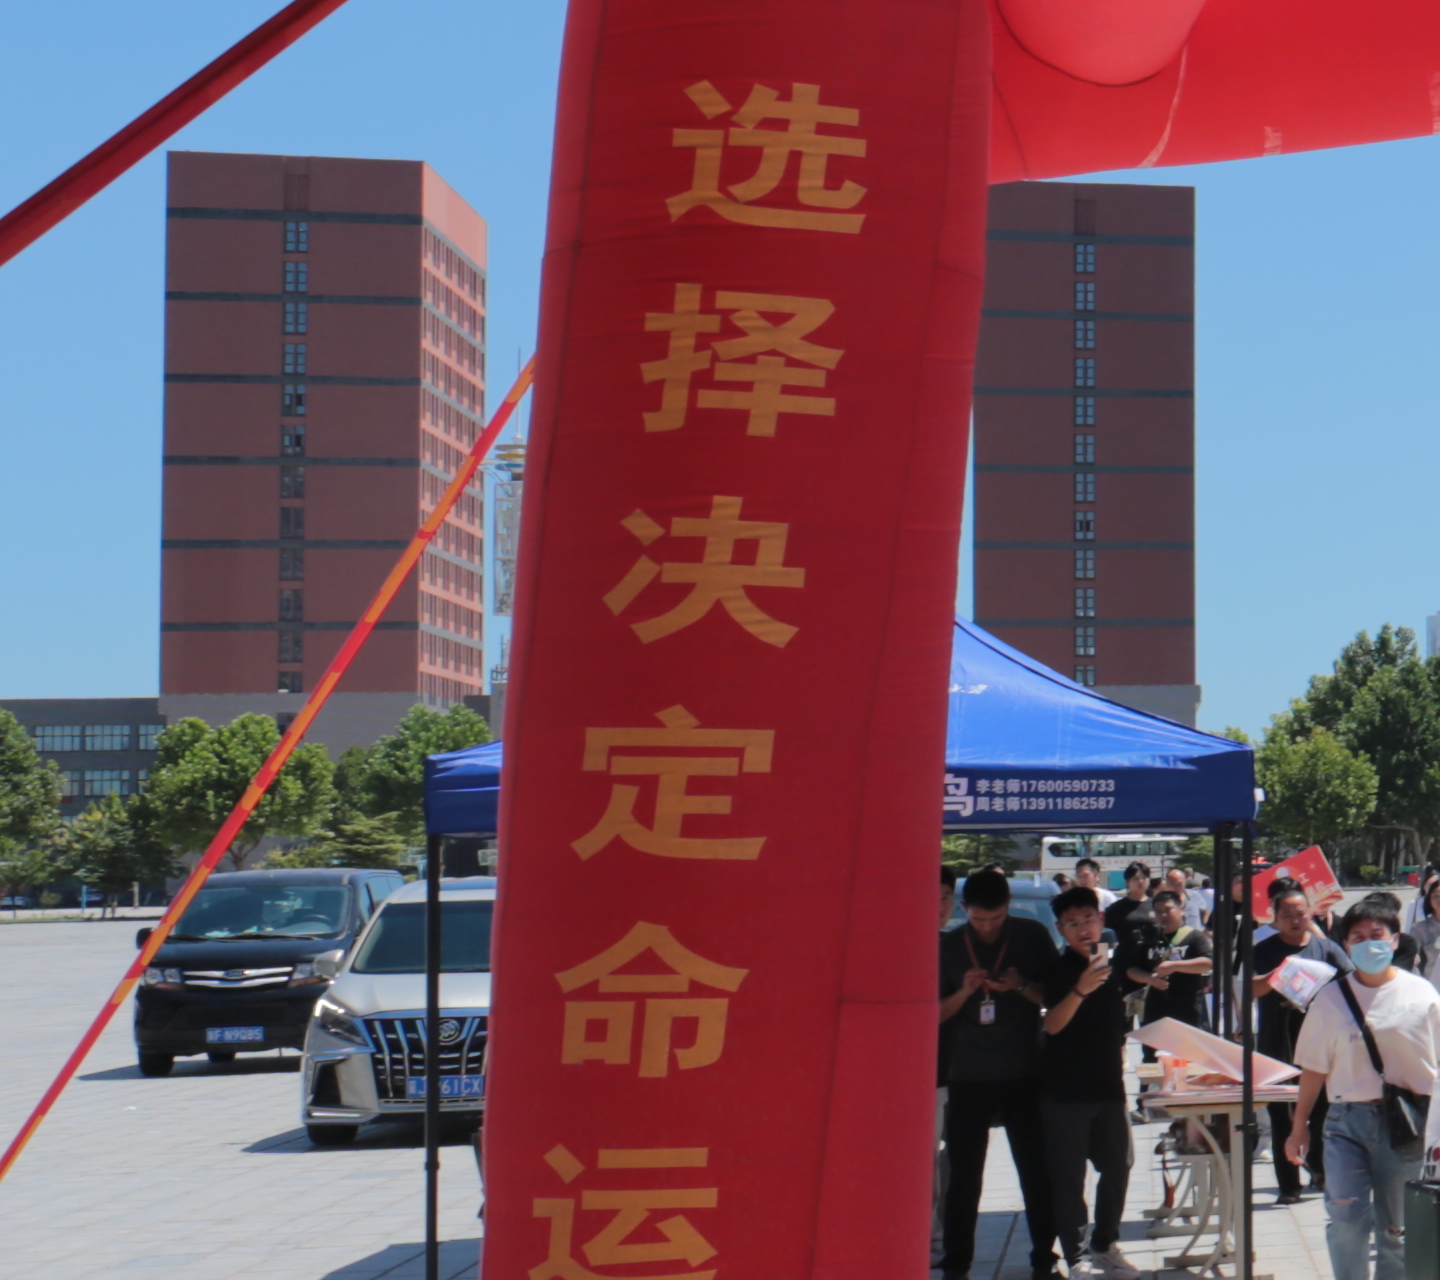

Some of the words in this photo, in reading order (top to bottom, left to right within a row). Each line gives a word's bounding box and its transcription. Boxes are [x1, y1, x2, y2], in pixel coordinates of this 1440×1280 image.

[976, 778, 1115, 794] 李老师17600590733
[976, 796, 1115, 812] 周老师13911862587
